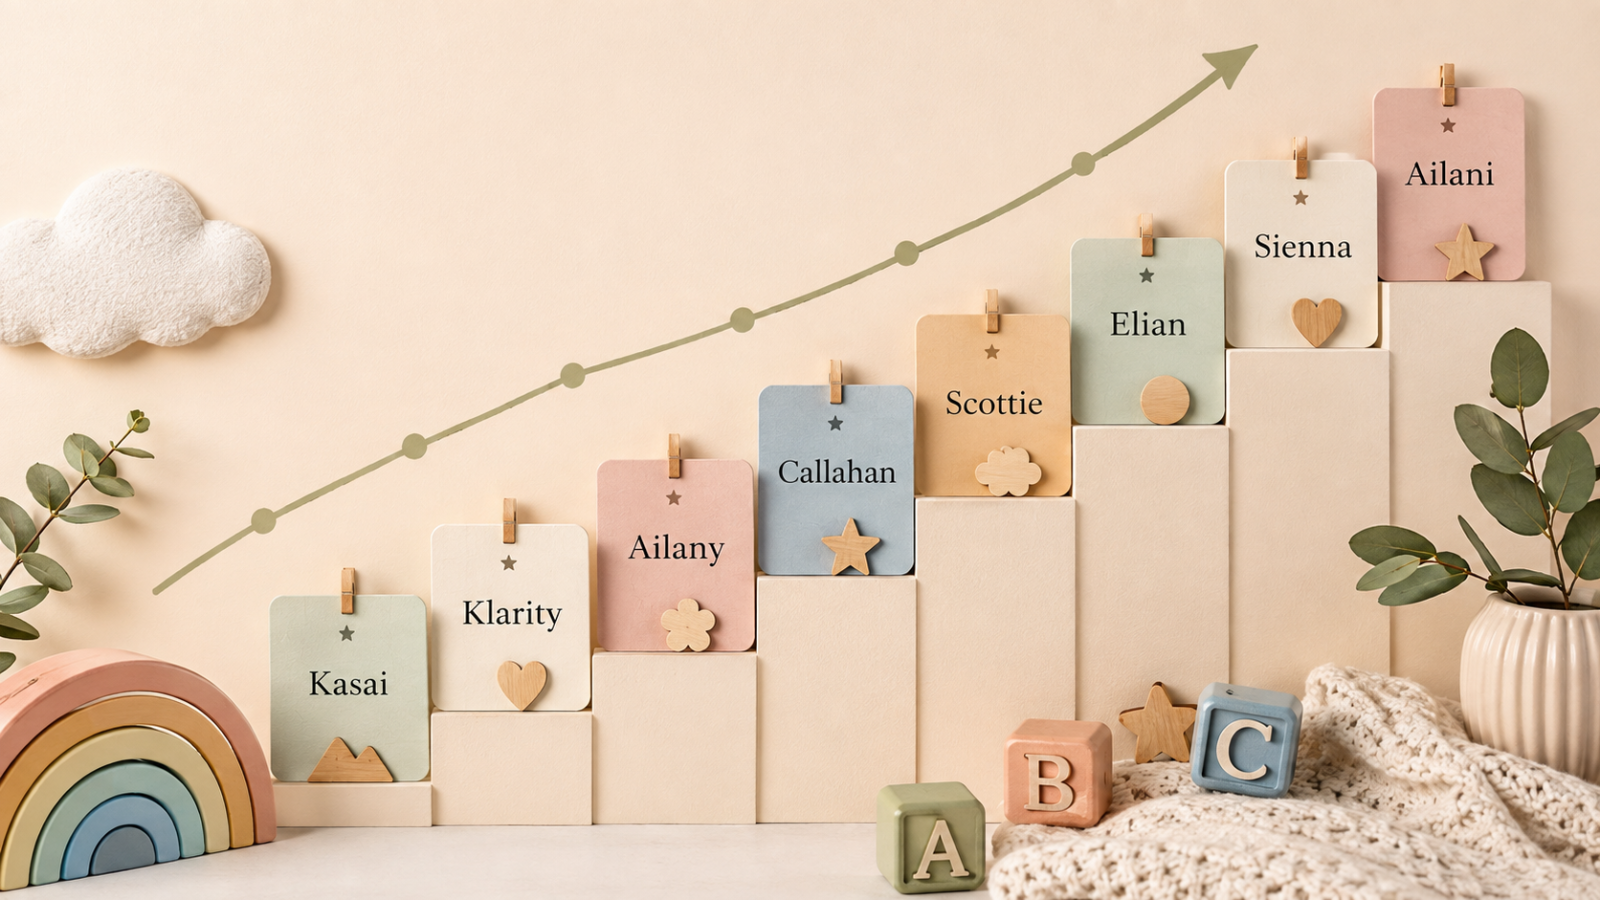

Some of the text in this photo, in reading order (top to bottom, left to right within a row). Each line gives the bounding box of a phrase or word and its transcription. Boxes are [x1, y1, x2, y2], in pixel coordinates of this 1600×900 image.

[1405, 159, 1495, 187] Ailani
[1254, 233, 1353, 259] Sienna
[1110, 310, 1187, 337] Elian
[945, 390, 1043, 416] Scottie
[777, 458, 897, 484] Callahan
[627, 533, 726, 568] Ailany
[462, 598, 563, 633] Klarity
[308, 670, 389, 697] Kasai
[1216, 719, 1273, 780] C
[1023, 753, 1075, 811] B
[913, 819, 969, 879] A
